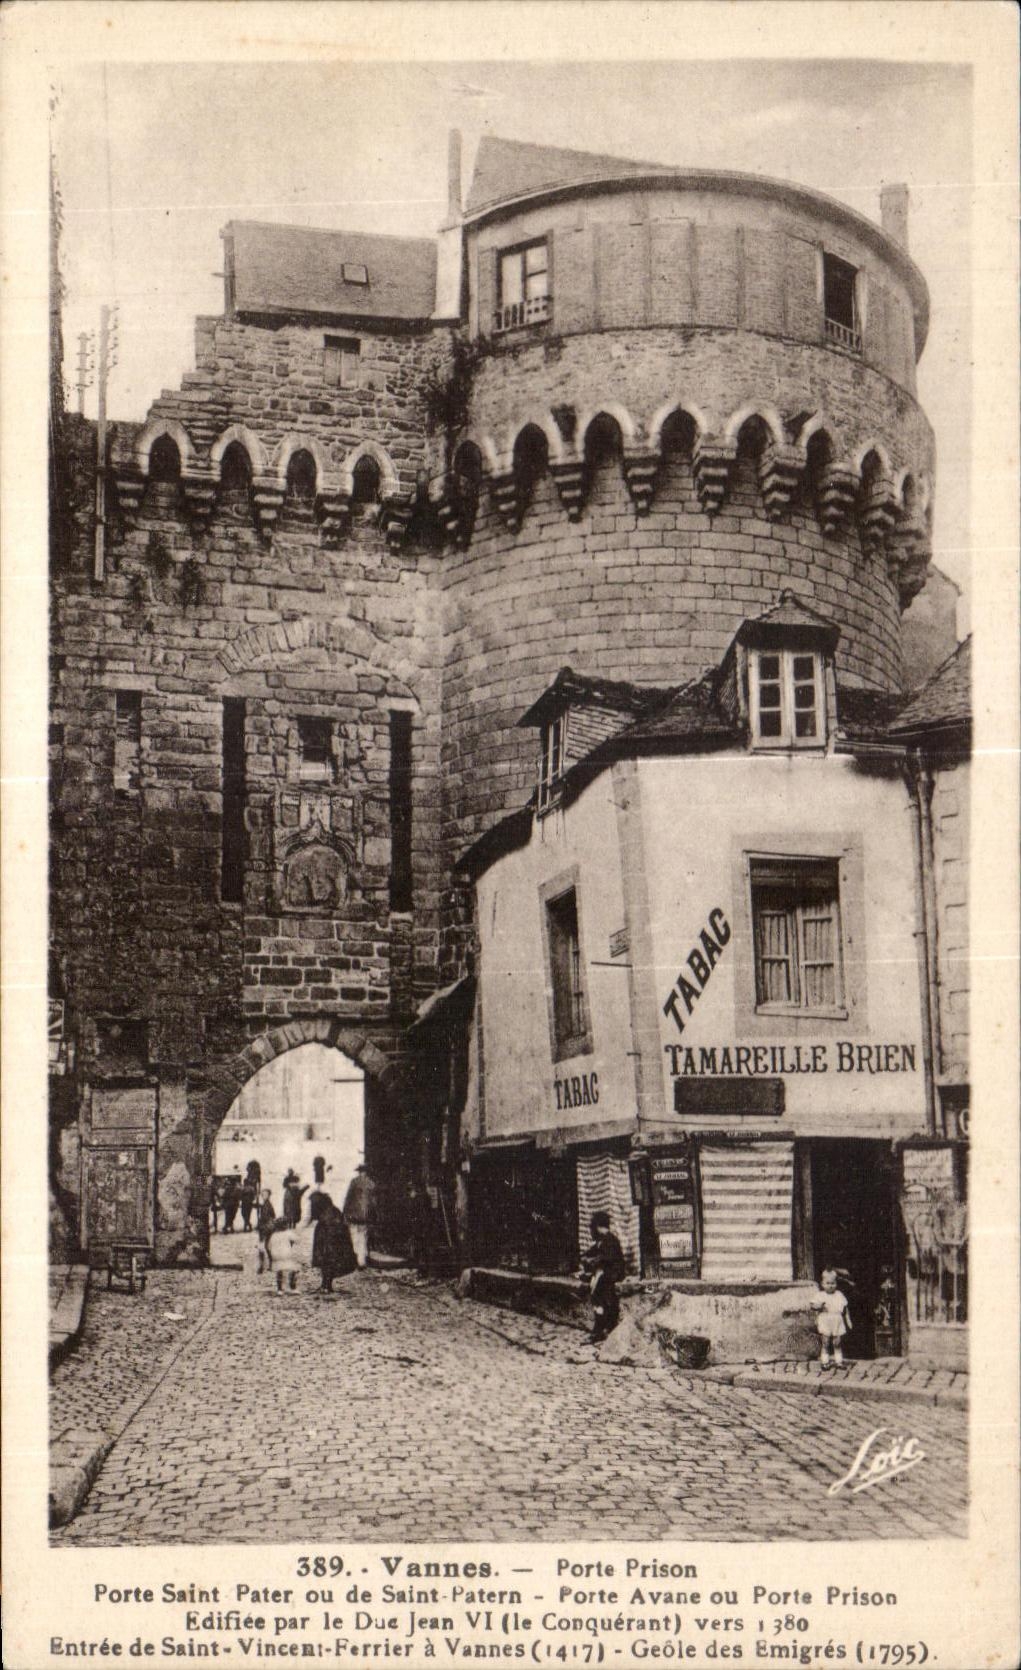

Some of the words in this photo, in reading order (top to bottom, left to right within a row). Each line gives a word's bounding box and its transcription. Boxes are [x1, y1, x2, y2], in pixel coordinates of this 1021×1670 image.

[663, 907, 732, 1033] TABAC
[664, 1043, 828, 1076] TAMAREILLE
[836, 1041, 917, 1074] BRIEN
[553, 1072, 599, 1110] TABAC
